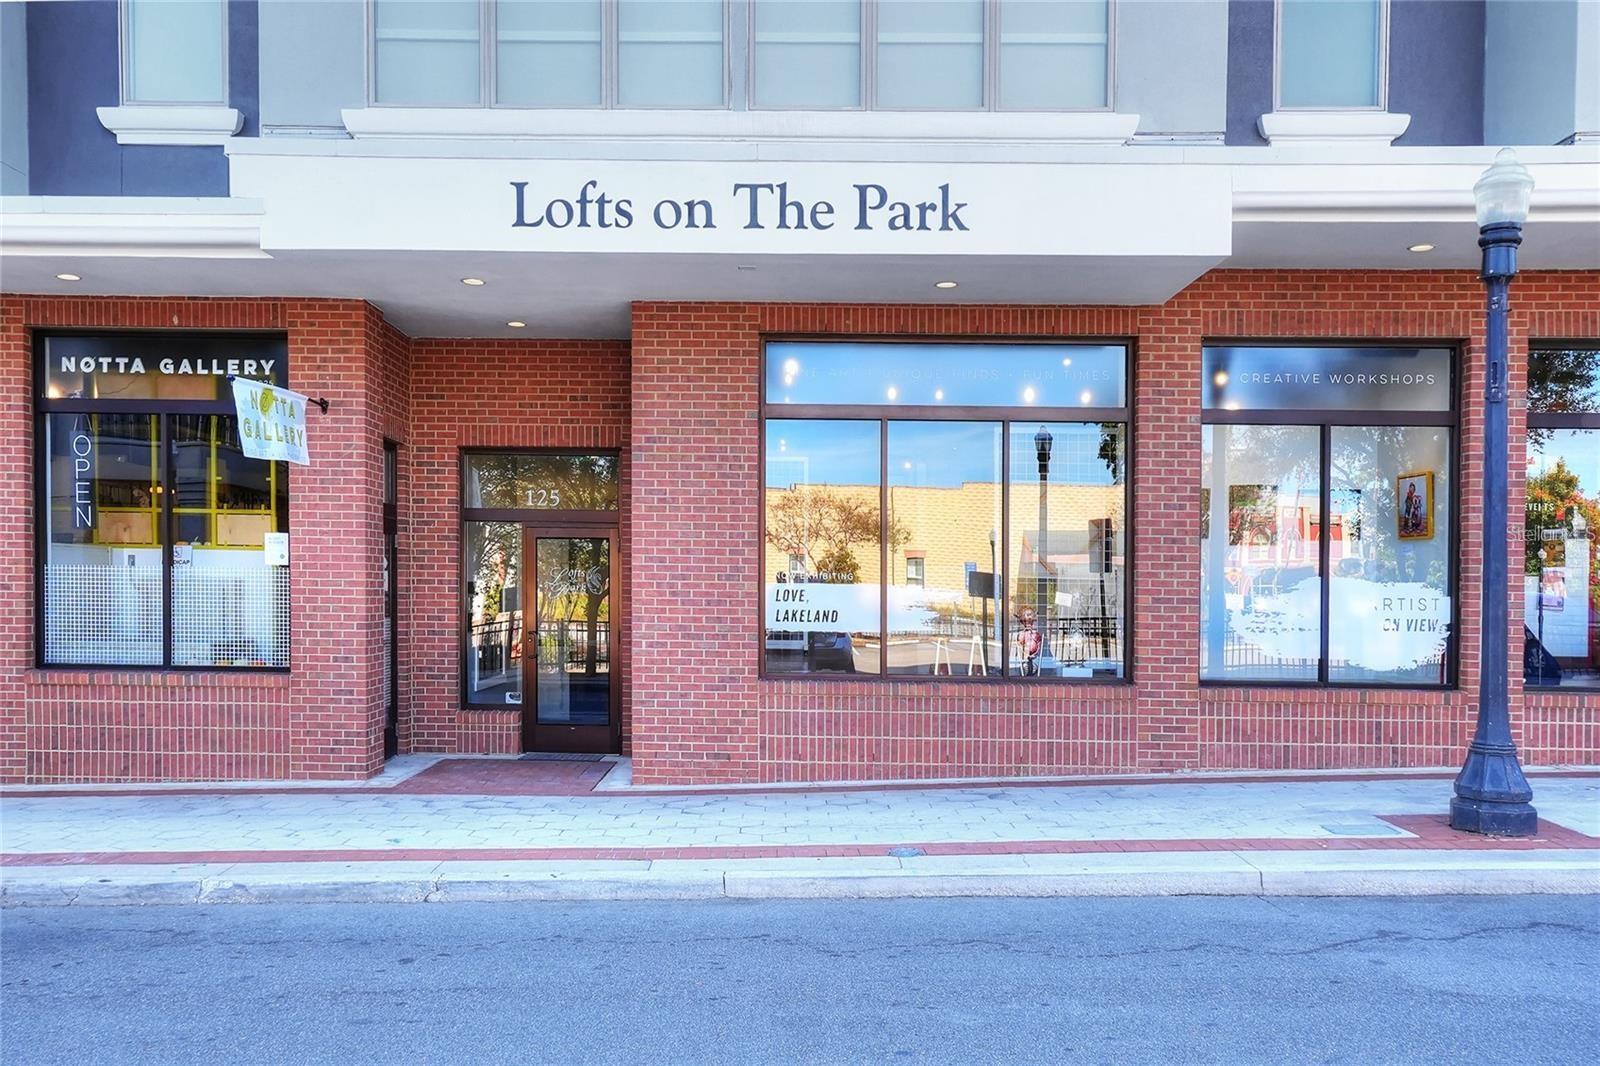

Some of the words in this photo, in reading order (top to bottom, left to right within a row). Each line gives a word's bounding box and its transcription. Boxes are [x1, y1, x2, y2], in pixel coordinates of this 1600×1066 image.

[509, 179, 633, 229] Lofts
[653, 198, 717, 230] on
[733, 181, 835, 231] The
[852, 182, 970, 232] Park
[159, 357, 275, 376] GALLERY
[1240, 373, 1320, 385] CREATIVE
[1329, 373, 1435, 385] WORKSHOPS
[243, 418, 303, 447] GALLERY
[73, 435, 92, 528] OPEN
[525, 489, 560, 507] 125
[775, 588, 809, 603] LOVE,
[1374, 597, 1440, 612] RTIST
[775, 608, 839, 624] LAKELAND
[1406, 618, 1439, 632] VIEW
